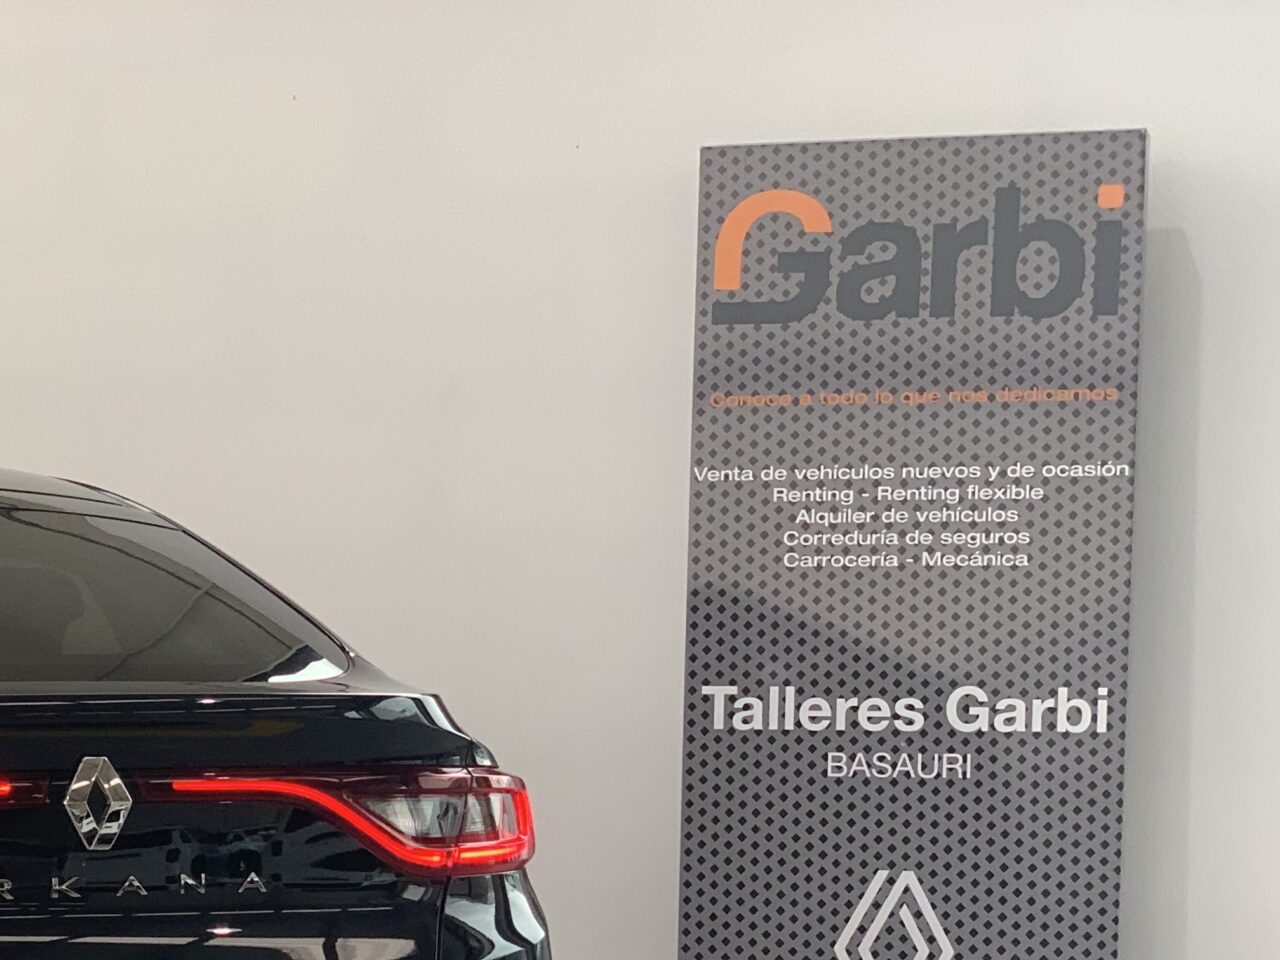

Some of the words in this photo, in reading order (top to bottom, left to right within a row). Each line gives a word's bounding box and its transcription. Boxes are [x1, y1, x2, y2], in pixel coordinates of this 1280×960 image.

[712, 184, 1125, 325] Garbi
[821, 390, 867, 405] todo
[875, 389, 893, 405] lo
[902, 391, 940, 404] que
[949, 391, 987, 402] nos
[996, 387, 1118, 402] dedicamos
[693, 466, 754, 481] Venta
[760, 465, 788, 480] de
[794, 464, 895, 480] vehículos
[902, 464, 981, 478] nuevos
[988, 465, 1000, 481] y
[1007, 462, 1035, 477] de
[1042, 461, 1129, 477] ocasión
[773, 487, 854, 505] Renting
[877, 485, 960, 504] Renting
[967, 484, 1044, 500] flexible
[795, 508, 875, 527] Alquiler
[881, 508, 909, 523] de
[916, 507, 1019, 523] vehículos
[783, 530, 899, 546] Correduría
[905, 530, 933, 545] de
[940, 531, 1030, 548] seguros
[783, 551, 899, 568] Carrocería
[922, 551, 1029, 567] Mecánica
[702, 685, 925, 733] Talleres
[945, 685, 1108, 733] Garbi
[827, 752, 972, 779] BASAURI
